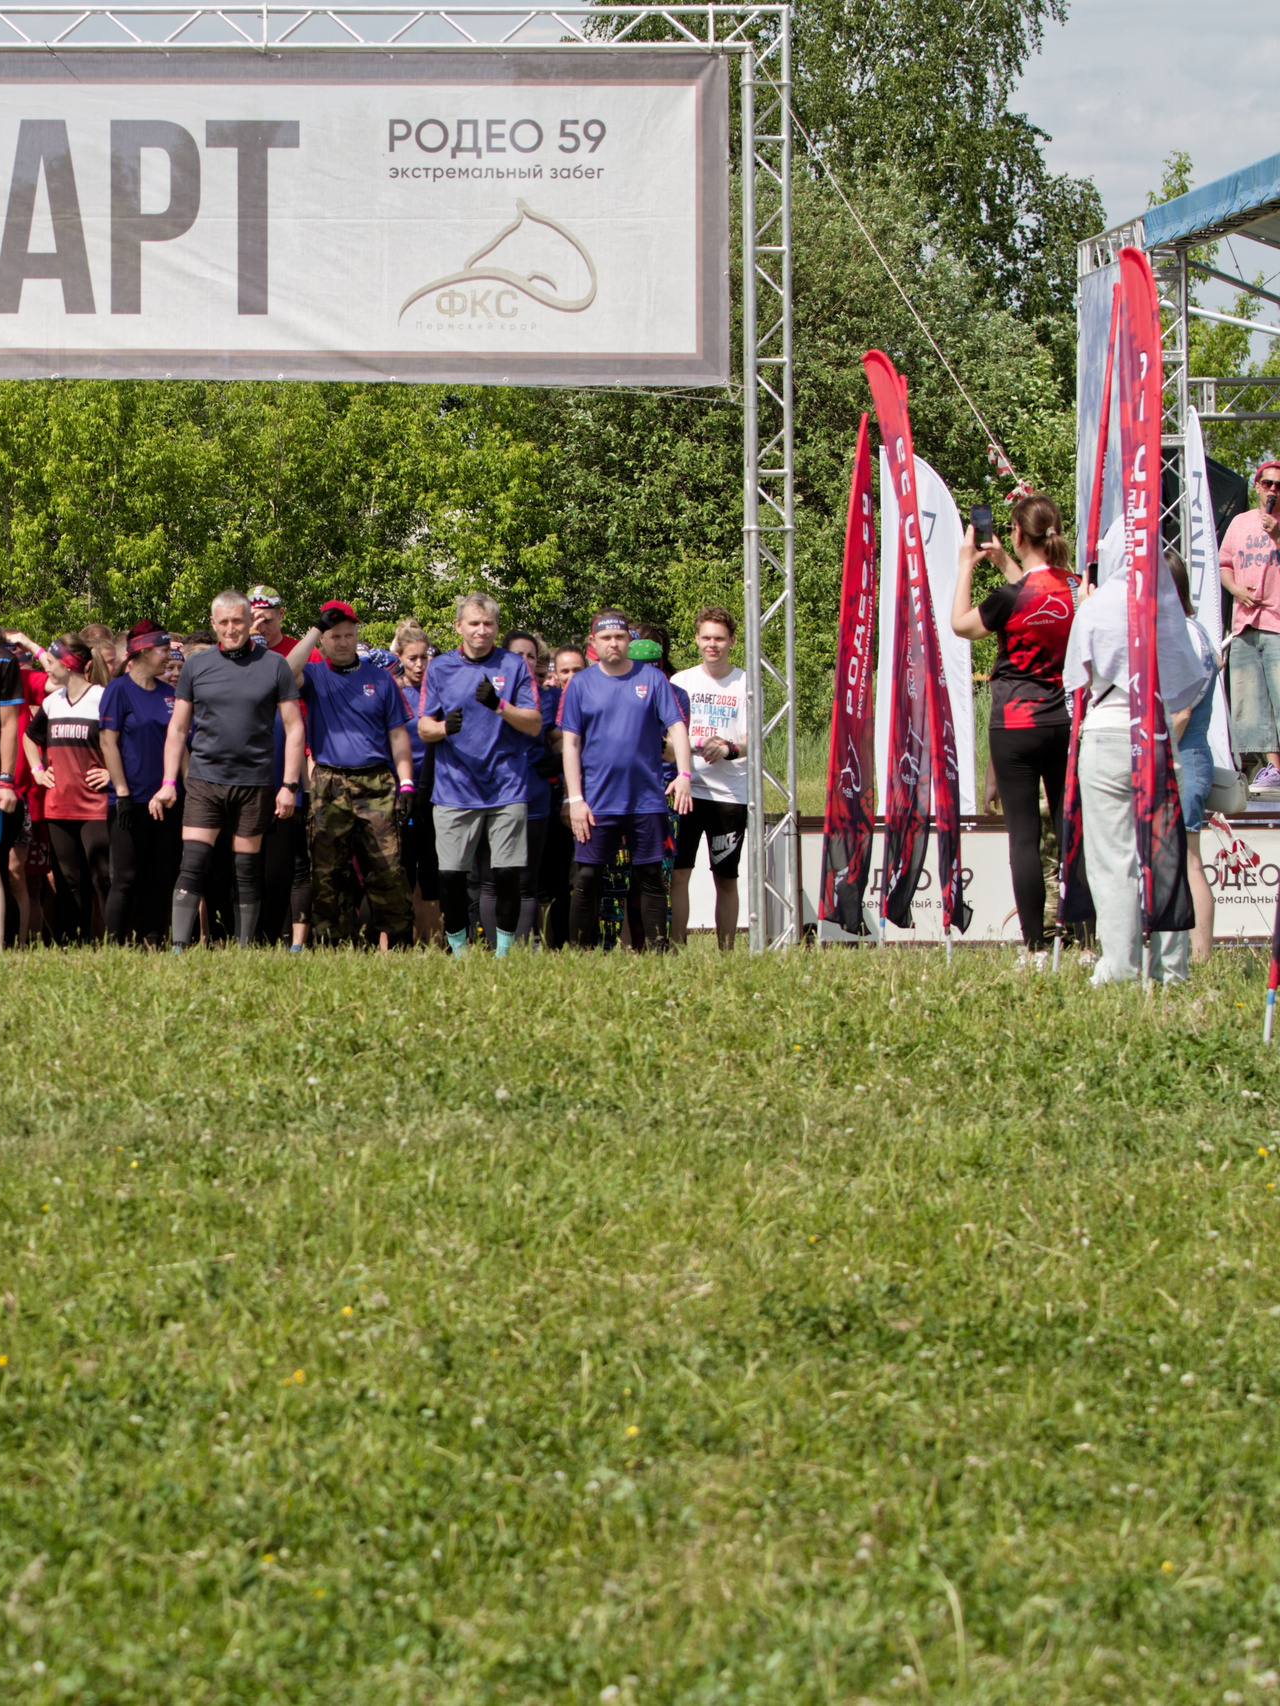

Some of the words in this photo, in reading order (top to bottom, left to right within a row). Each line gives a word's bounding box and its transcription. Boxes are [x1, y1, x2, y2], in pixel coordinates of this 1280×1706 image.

[389, 118, 543, 159] РОДЕО
[558, 119, 606, 153] 59
[389, 164, 543, 182] экстремальный
[550, 164, 604, 179] забег
[436, 289, 518, 318] ФКС
[416, 321, 493, 332] Пермский
[500, 320, 537, 332] край
[711, 831, 737, 851] NIKE
